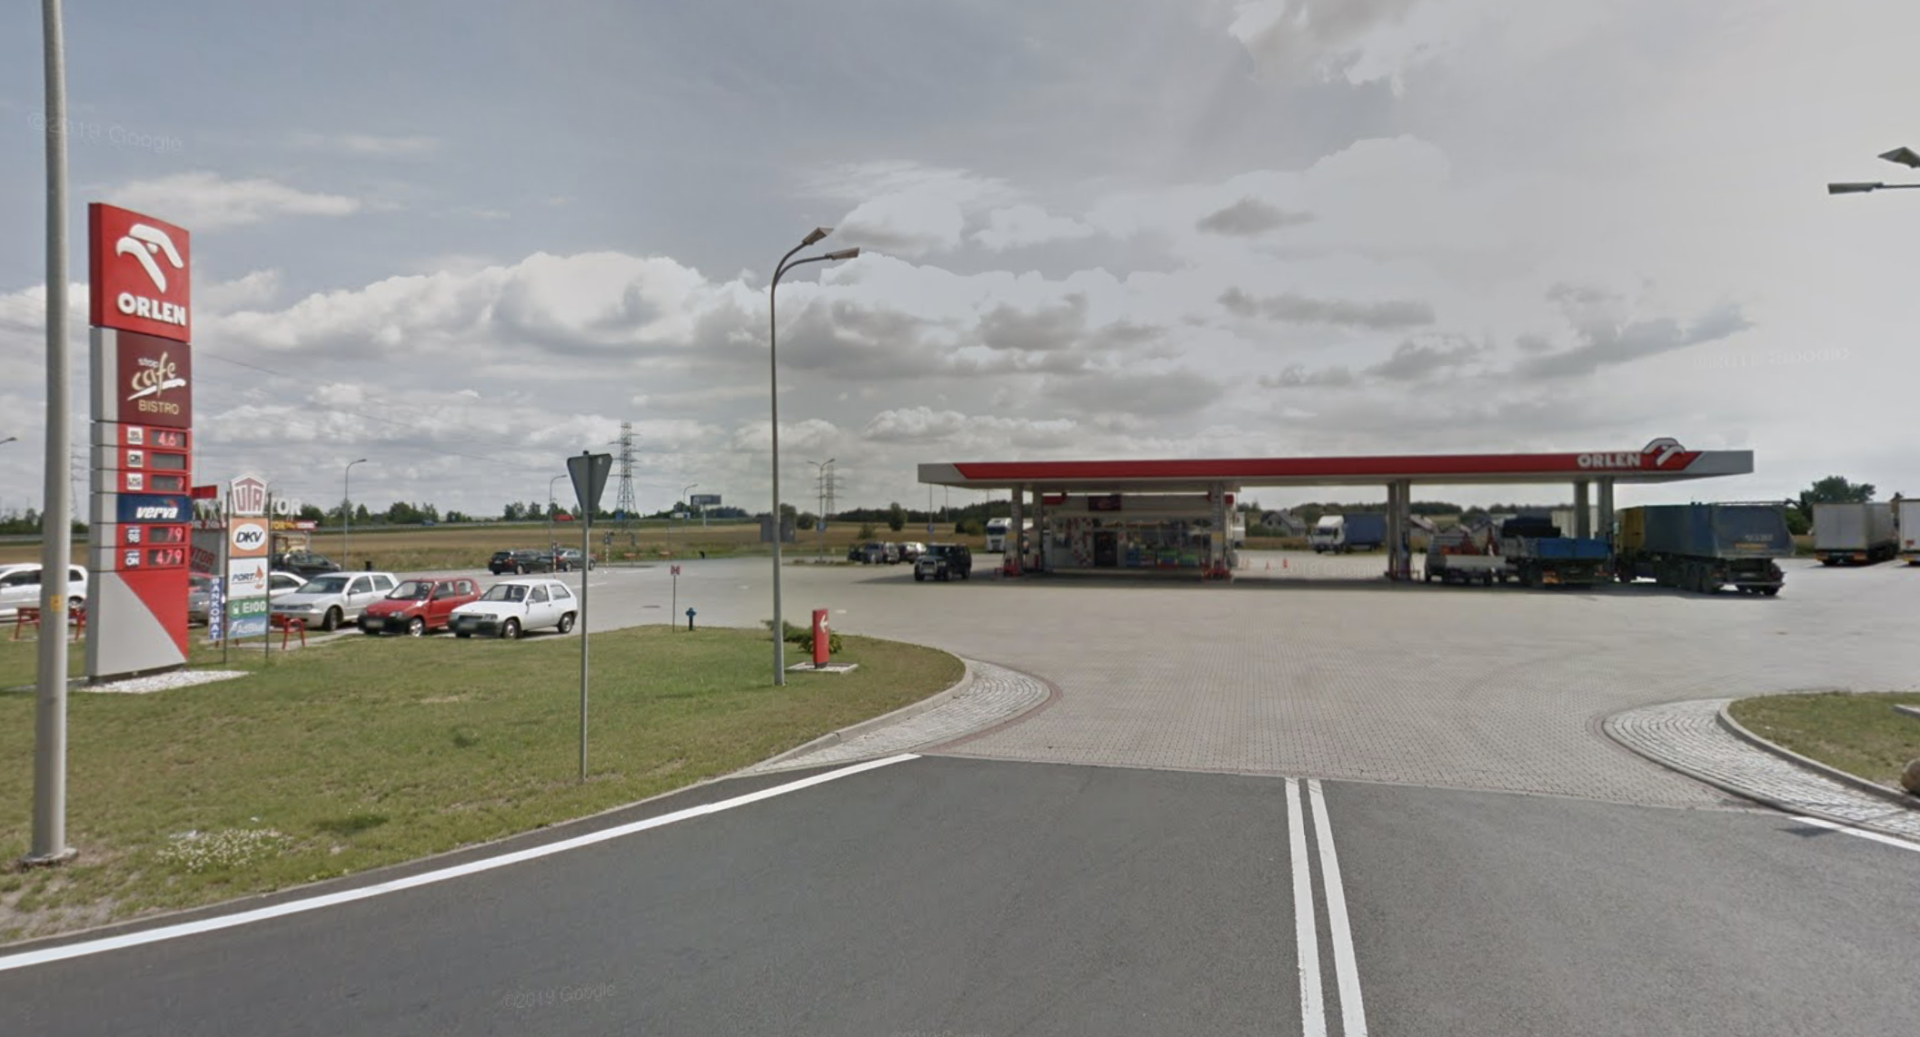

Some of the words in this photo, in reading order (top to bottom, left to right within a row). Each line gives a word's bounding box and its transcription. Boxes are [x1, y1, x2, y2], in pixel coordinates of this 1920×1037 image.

[117, 292, 187, 326] ORLEN
[138, 399, 180, 415] BISTRO
[1577, 453, 1642, 468] ORLEN
[135, 506, 179, 519] verva
[235, 531, 263, 544] DKV
[231, 572, 255, 582] PORT
[210, 577, 221, 639] BANKOMAT
[242, 601, 267, 614] E100
